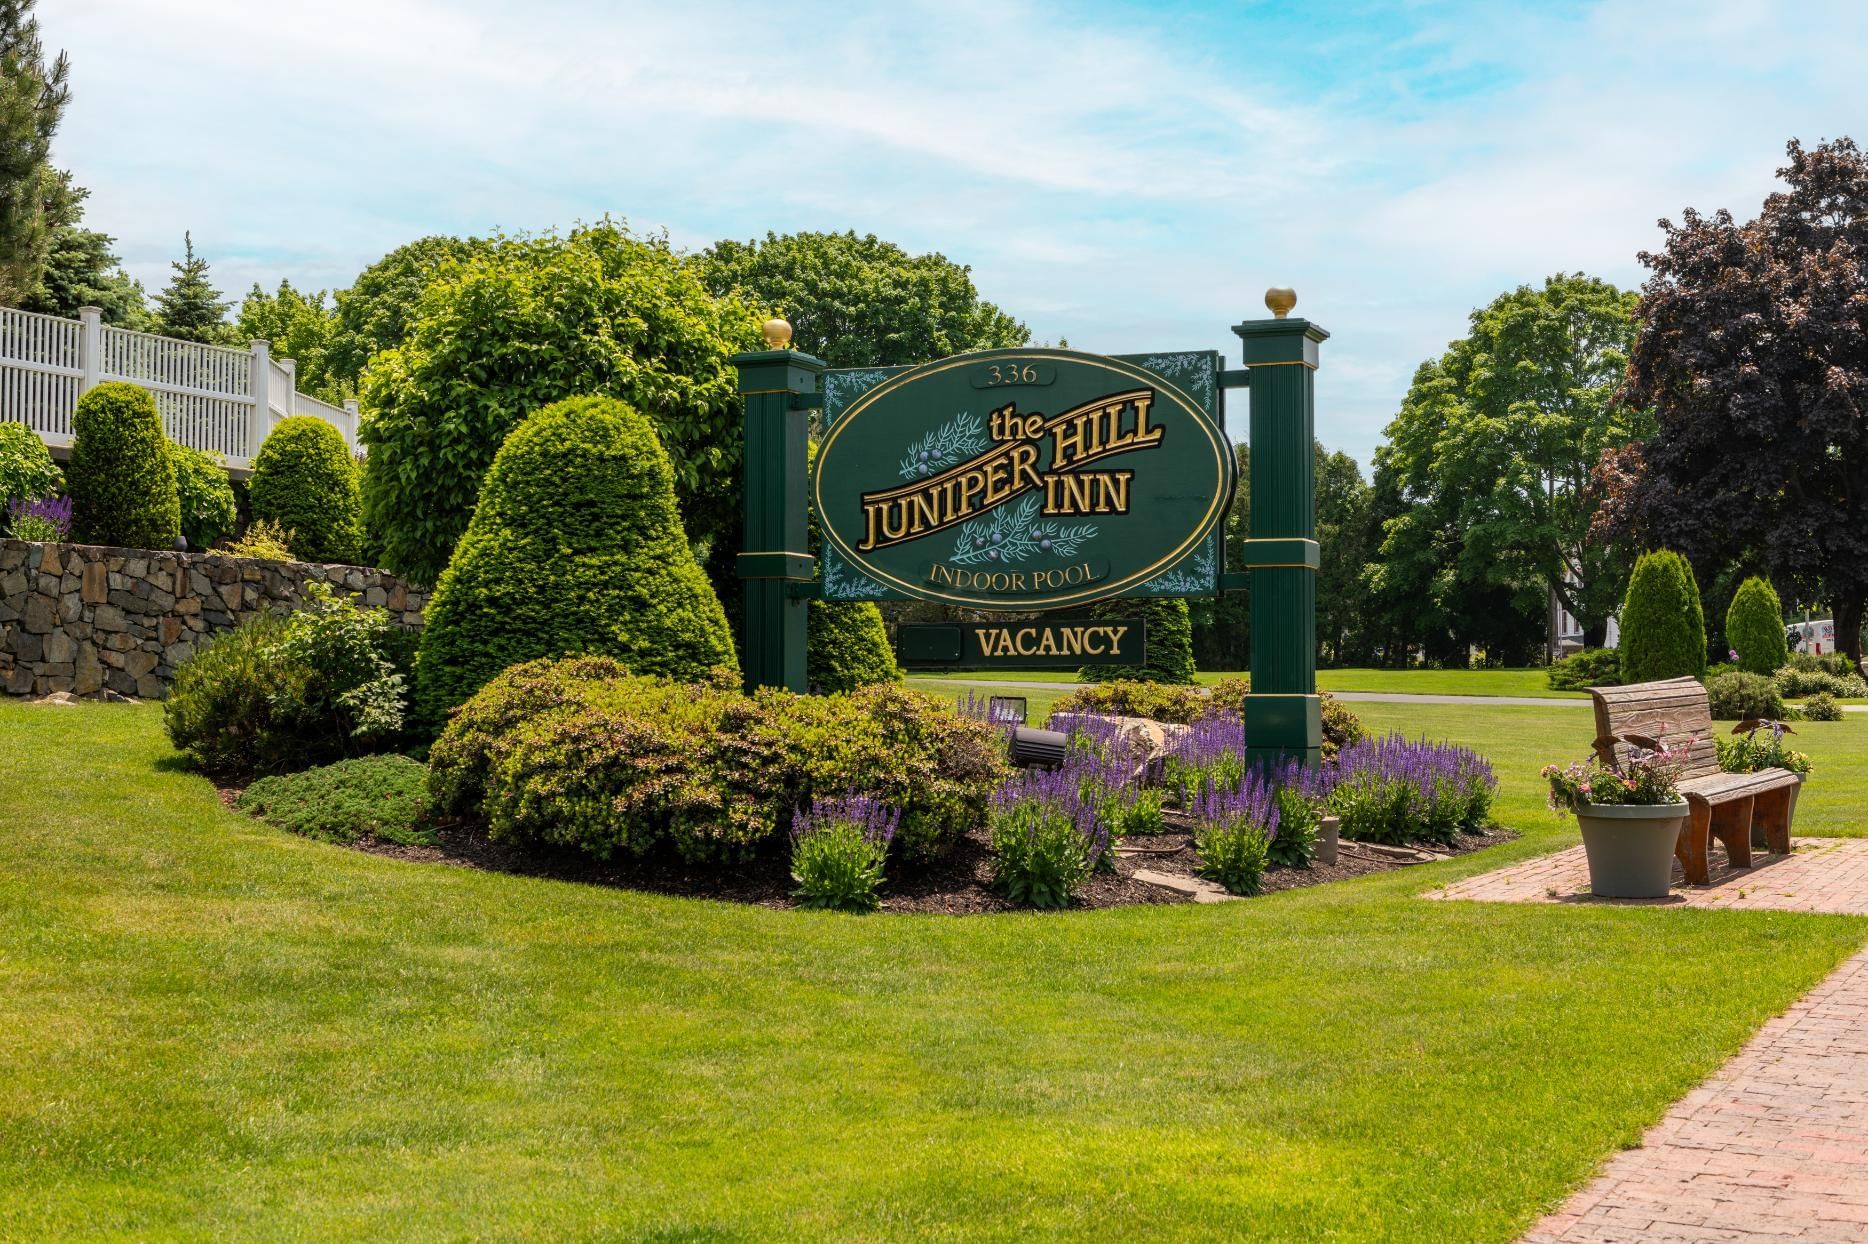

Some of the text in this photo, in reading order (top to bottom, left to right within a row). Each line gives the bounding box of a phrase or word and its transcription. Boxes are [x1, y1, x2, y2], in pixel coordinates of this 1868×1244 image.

[988, 364, 1039, 385] 336
[990, 406, 1044, 441] the
[859, 398, 1162, 551] JUNIPER HILL
[1043, 472, 1132, 514] INN
[929, 562, 1099, 592] INDOOR POOL
[975, 626, 1128, 657] VACANCY
